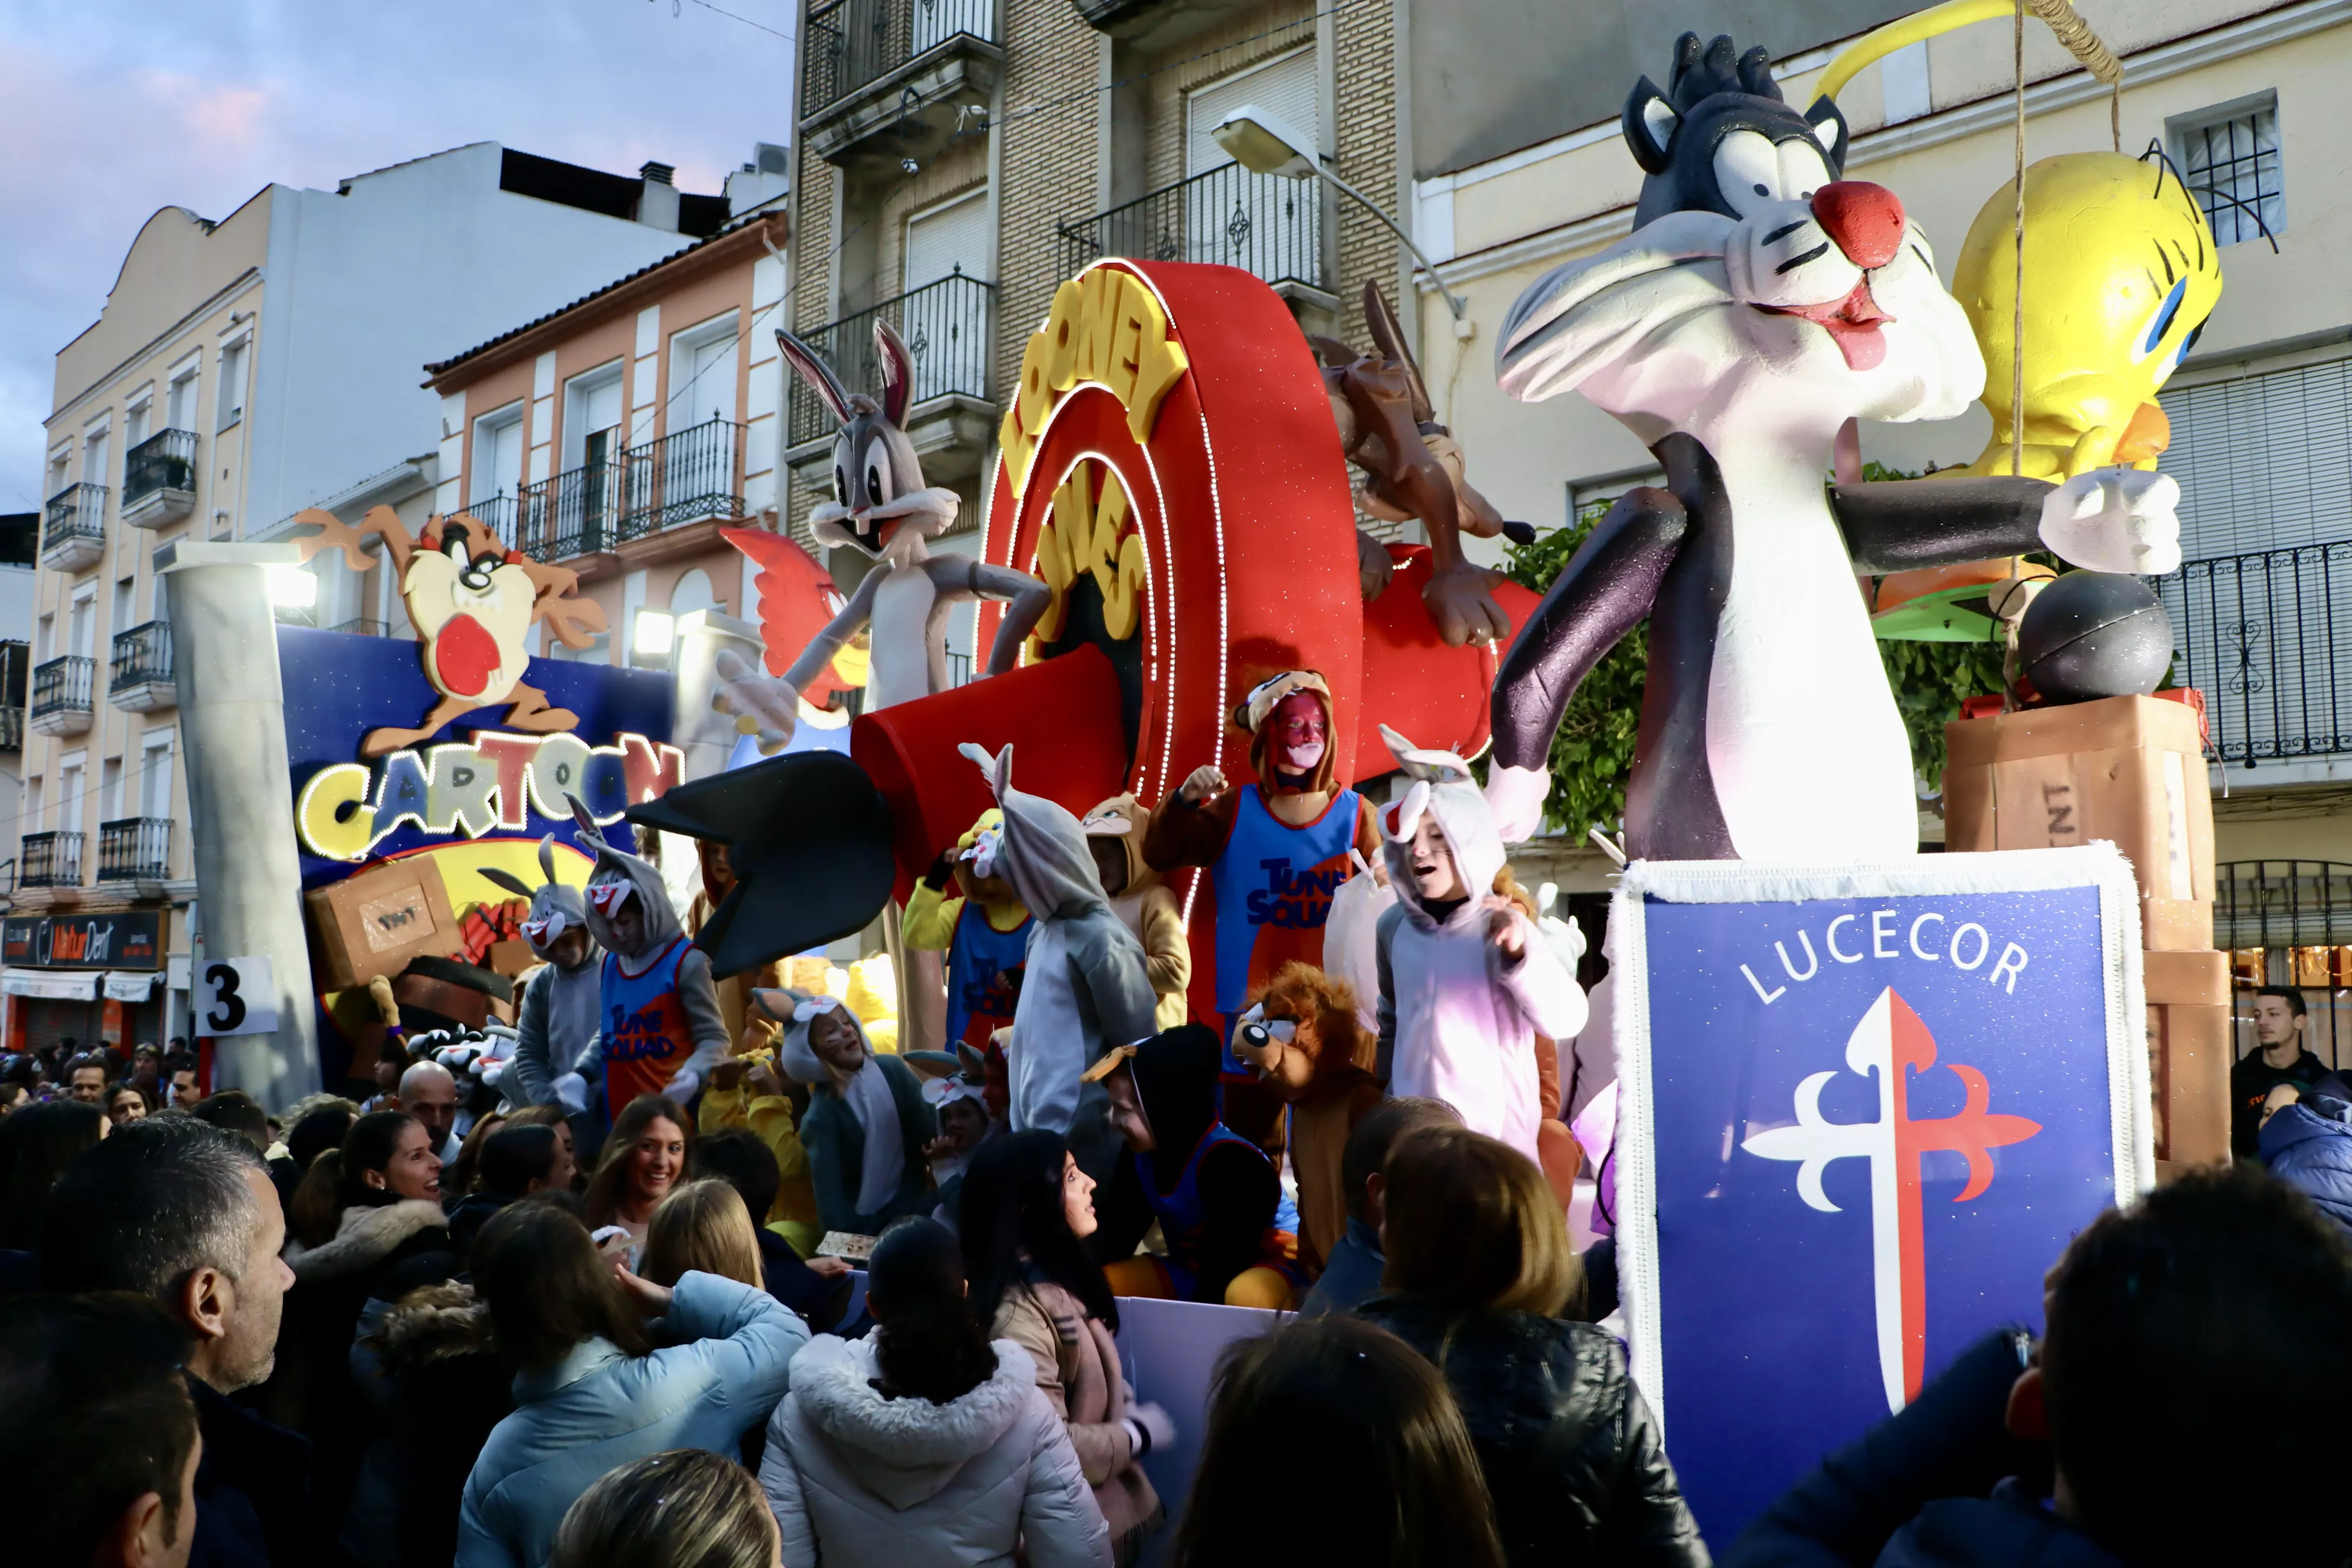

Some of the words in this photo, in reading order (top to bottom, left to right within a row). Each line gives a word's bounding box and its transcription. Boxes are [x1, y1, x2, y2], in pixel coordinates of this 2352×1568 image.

[999, 267, 1189, 499] LOONEY
[1025, 460, 1146, 666] UNES
[298, 730, 687, 862] CARTOON
[2043, 780, 2076, 848] NT
[205, 963, 246, 1032] 3
[1739, 910, 2029, 1005] LUCECOR
[600, 1031, 676, 1062] SQUAD
[612, 1004, 664, 1035] TUNE
